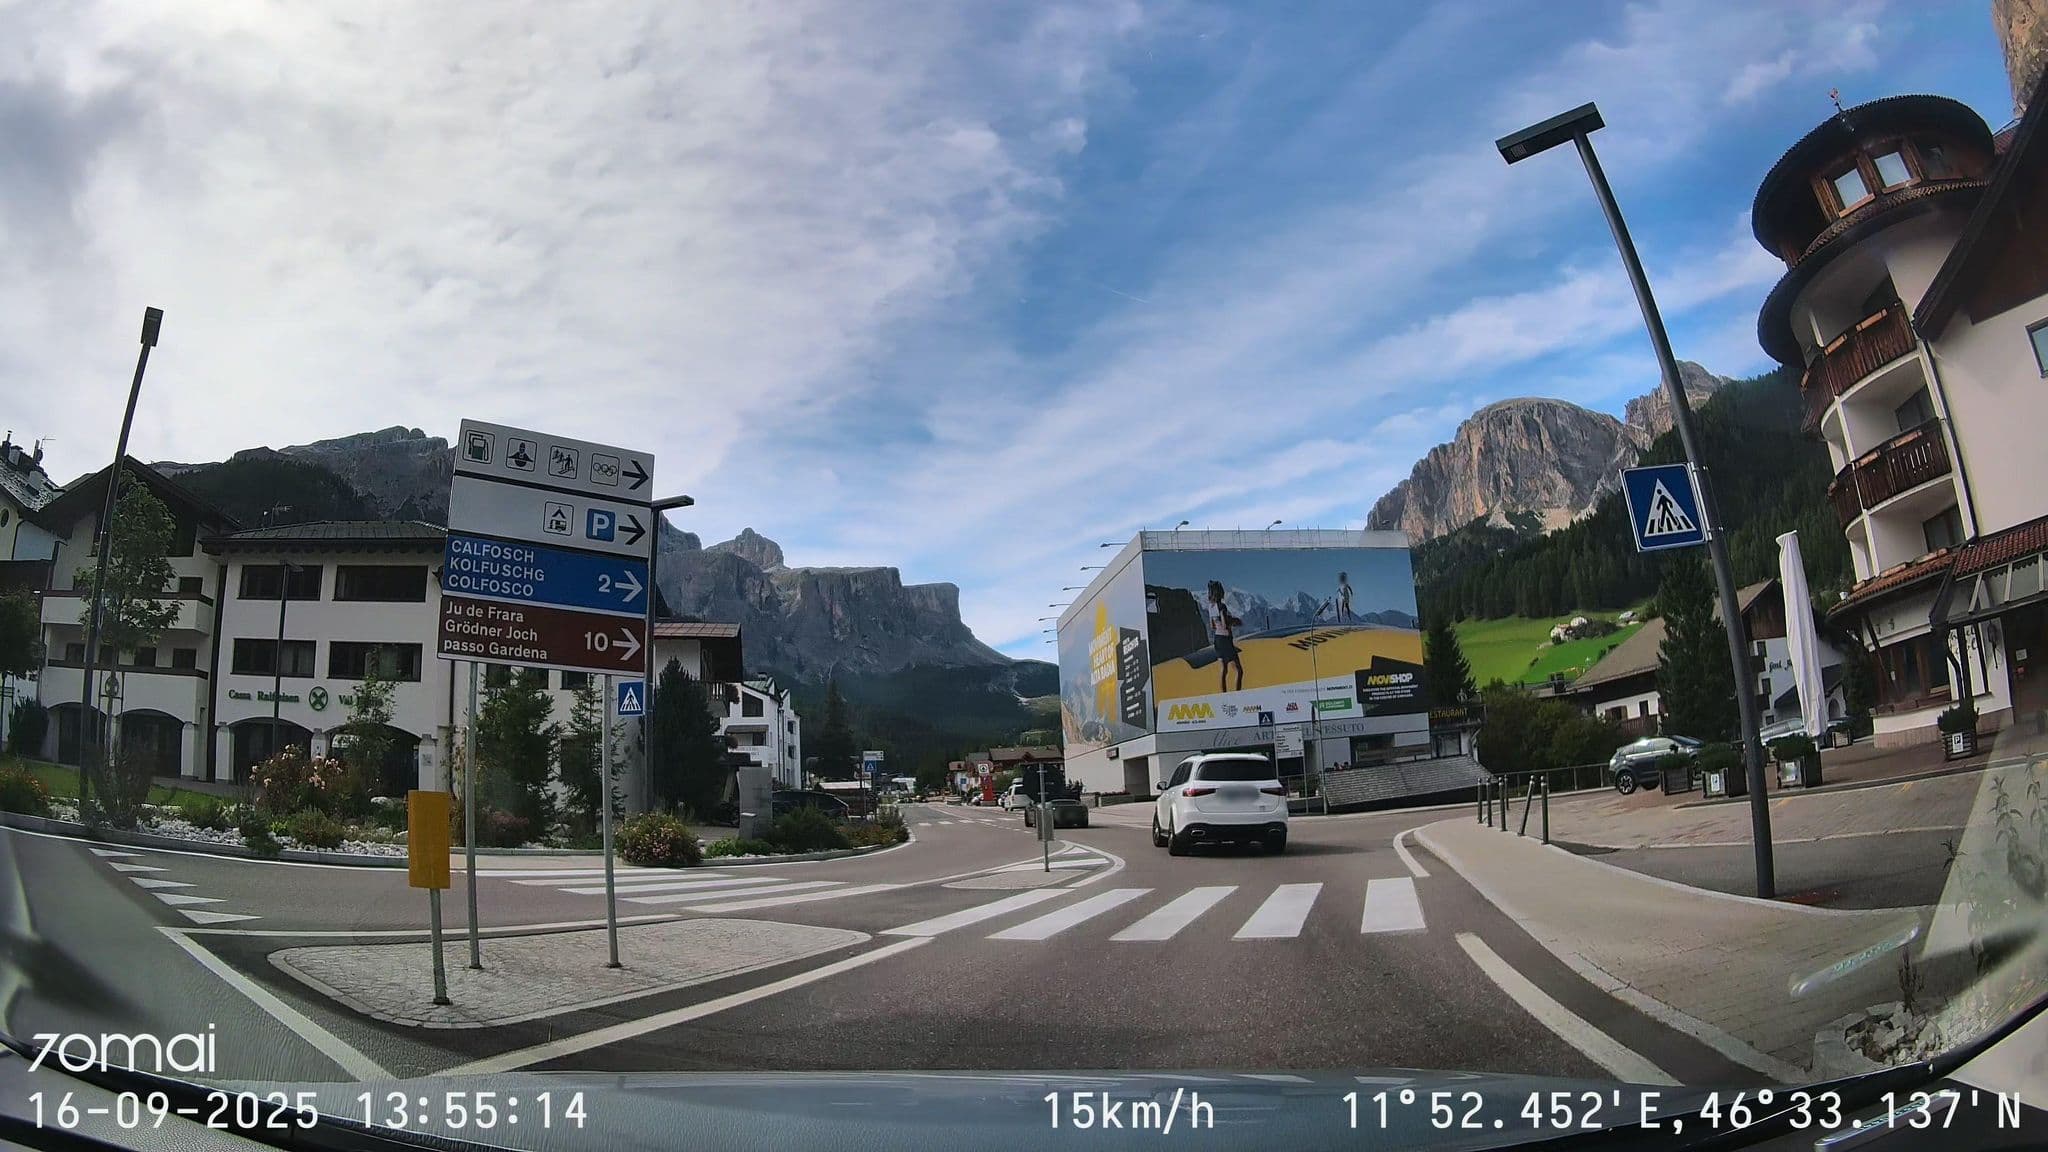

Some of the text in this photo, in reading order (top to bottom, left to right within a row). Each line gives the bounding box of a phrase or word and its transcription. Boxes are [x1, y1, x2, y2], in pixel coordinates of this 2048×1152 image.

[451, 540, 535, 563] CALFOSCH
[450, 557, 545, 582] KOLFUSCHG
[448, 574, 611, 597] COLFOSCO 2
[446, 601, 524, 623] Ju de Frara
[445, 619, 538, 642] Grödner Joch
[443, 631, 609, 660] passo Gardena 10
[1367, 673, 1413, 685] MOVISHOP
[1430, 707, 1468, 719] ESTAURANT
